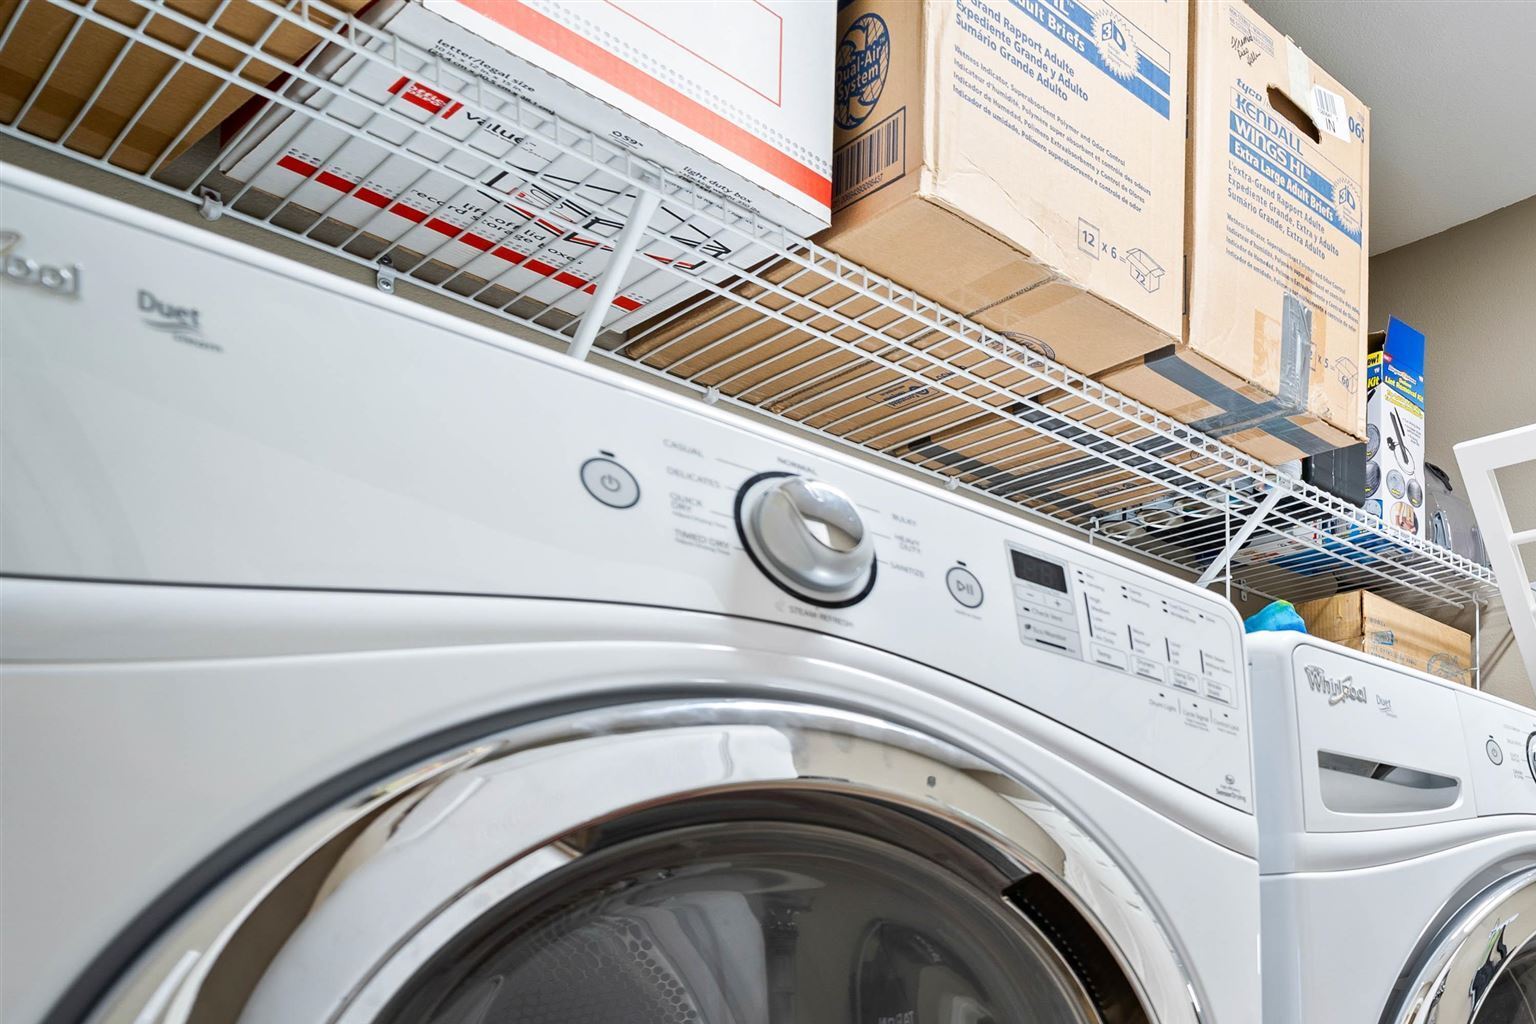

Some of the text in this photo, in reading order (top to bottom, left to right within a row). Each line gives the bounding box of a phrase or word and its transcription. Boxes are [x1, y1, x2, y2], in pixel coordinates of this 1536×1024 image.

[956, 0, 1089, 101] Expediente Grande y Adulto
[1003, 16, 1042, 53] Rapport
[1044, 48, 1075, 77] Adulte
[1048, 13, 1085, 52] Briefs
[956, 13, 1068, 101] Sumário Grande Adulto
[512, 78, 536, 92] size
[1236, 78, 1263, 101] tyco
[1234, 116, 1287, 166] WINGS
[1235, 93, 1303, 156] KENDALL
[682, 166, 752, 204] light duty box
[1234, 141, 1259, 169] Extra
[1260, 159, 1286, 188] Large
[1287, 178, 1309, 205] Adult
[1310, 194, 1333, 222] Briefs
[1228, 173, 1267, 207] Expediente
[1296, 220, 1312, 238] Extra
[1319, 236, 1339, 257] Adulto
[1276, 193, 1304, 218] Rapport
[1304, 213, 1325, 234] Adulte
[524, 229, 546, 241] lid
[1082, 230, 1096, 247] 12
[1110, 246, 1117, 259] 6
[1286, 226, 1303, 245] Extra
[1304, 239, 1325, 260] Adulto
[1135, 269, 1146, 286] 72
[137, 289, 201, 328] Duet
[1367, 376, 1380, 389] Kit
[662, 438, 704, 458] CASUAL
[1304, 664, 1368, 706] Whirlpool
